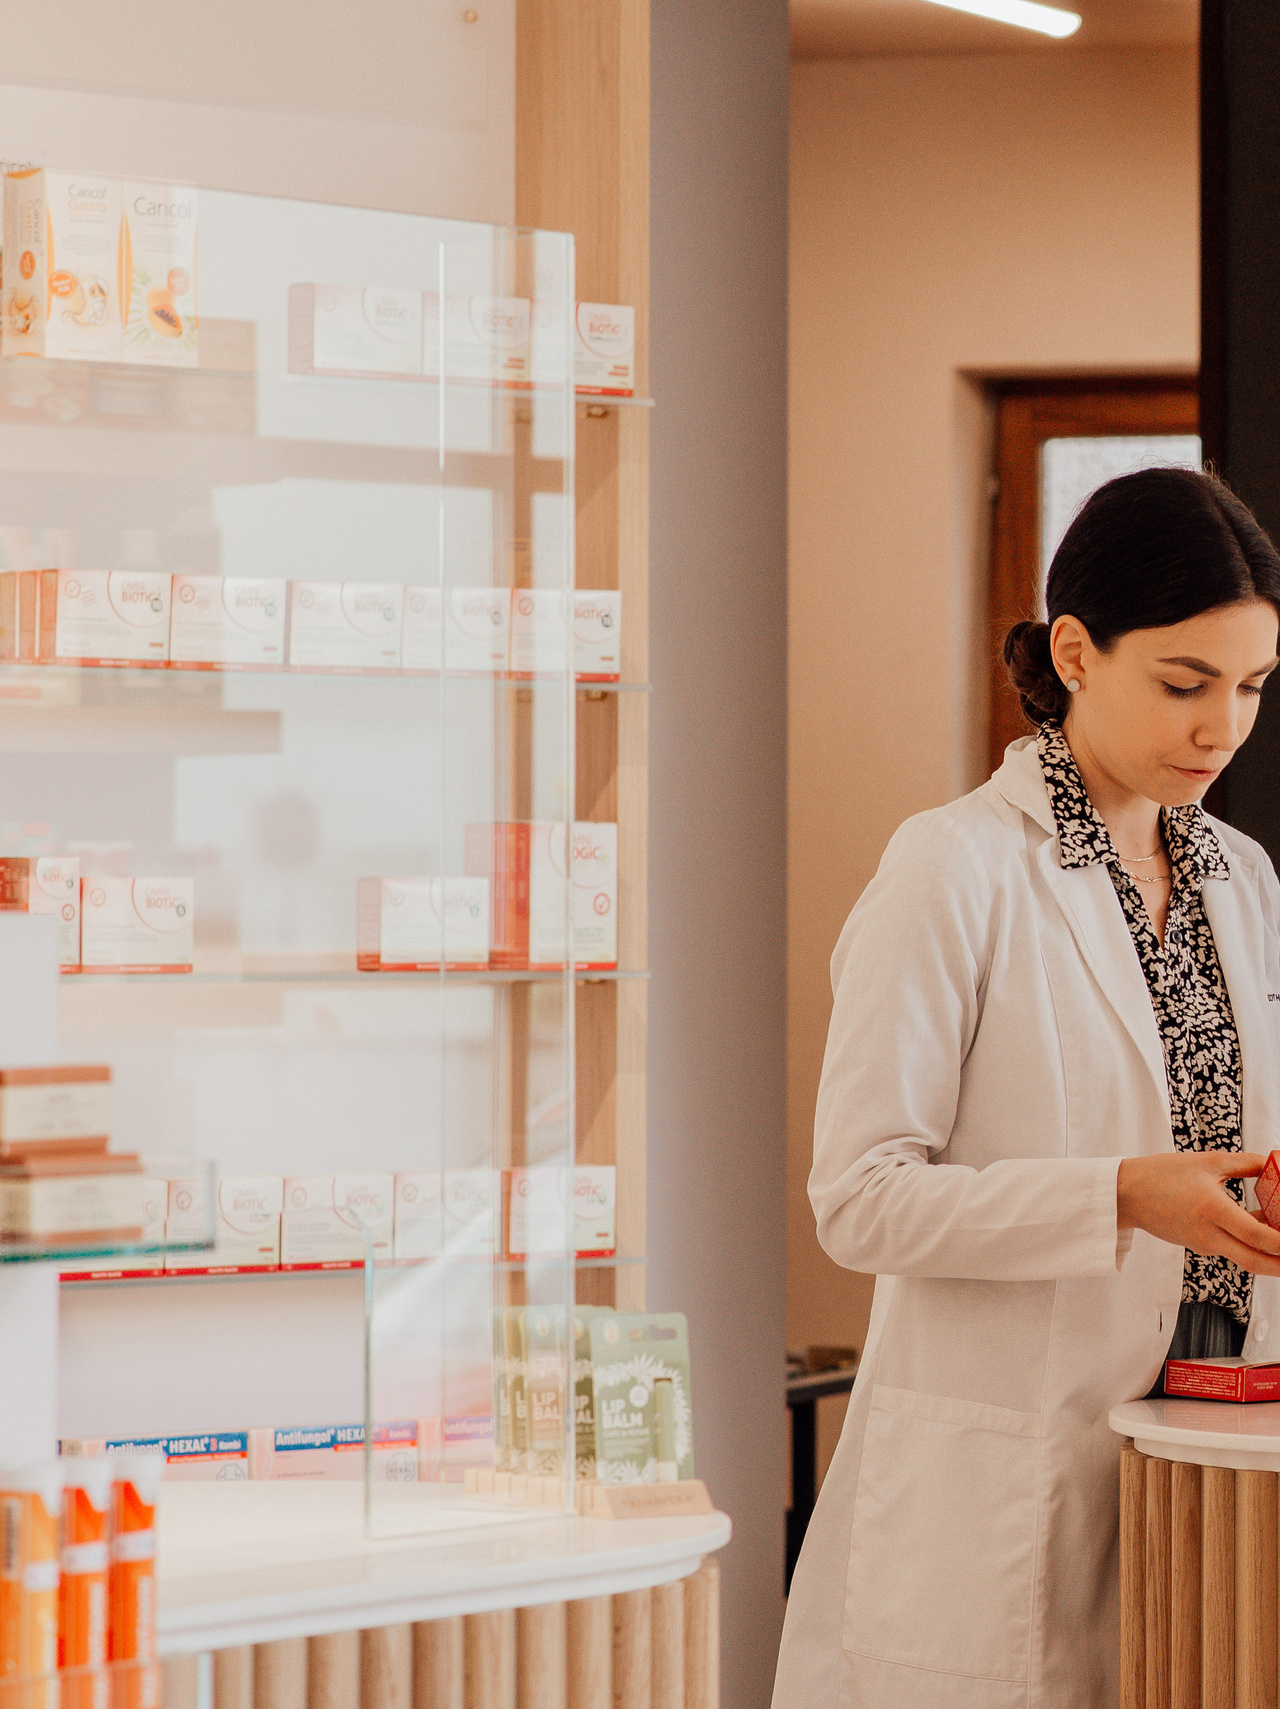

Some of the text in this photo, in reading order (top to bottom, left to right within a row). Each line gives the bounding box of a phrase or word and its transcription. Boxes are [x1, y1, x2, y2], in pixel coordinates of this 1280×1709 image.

[134, 196, 193, 219] Caricol
[572, 847, 602, 860] OGiC
[532, 1391, 556, 1406] LIP
[602, 1398, 627, 1414] LIP
[533, 1406, 560, 1421] BAL
[602, 1412, 643, 1429] BALM
[210, 1438, 217, 1451] 3
[219, 1440, 242, 1451] Kombi
